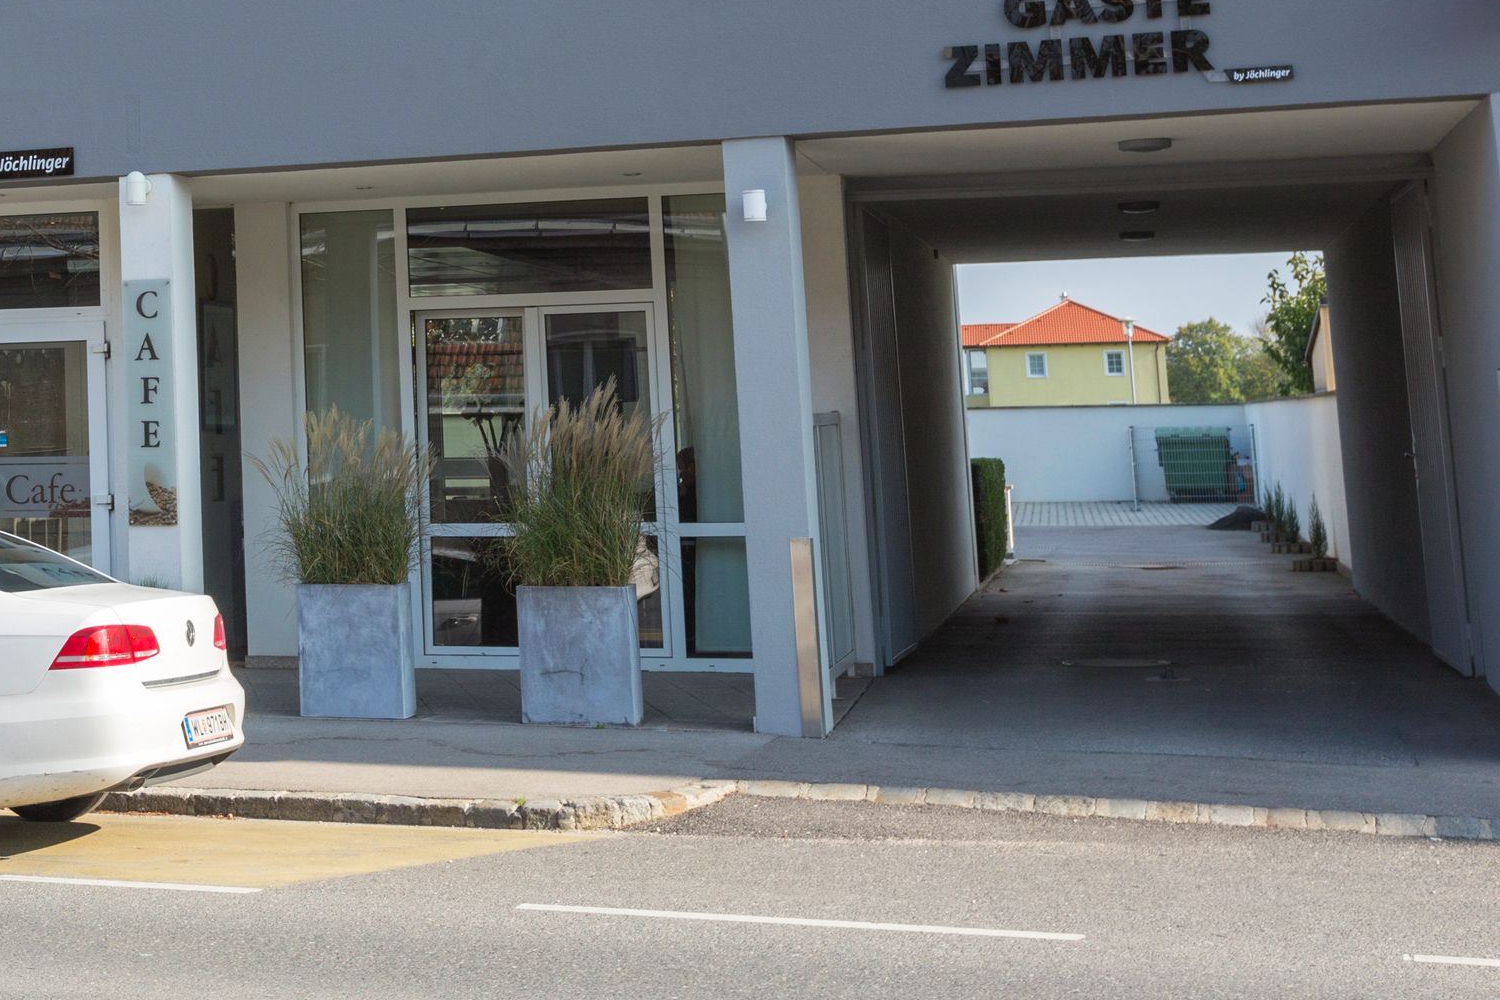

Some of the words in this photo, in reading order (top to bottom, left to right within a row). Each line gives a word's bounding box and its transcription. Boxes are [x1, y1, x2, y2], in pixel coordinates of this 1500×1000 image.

[944, 29, 1215, 88] ZIMMER
[1233, 71, 1245, 82] by
[1245, 68, 1291, 80] Jöchlinger
[134, 291, 161, 448] CAFE
[5, 472, 76, 505] Cafe
